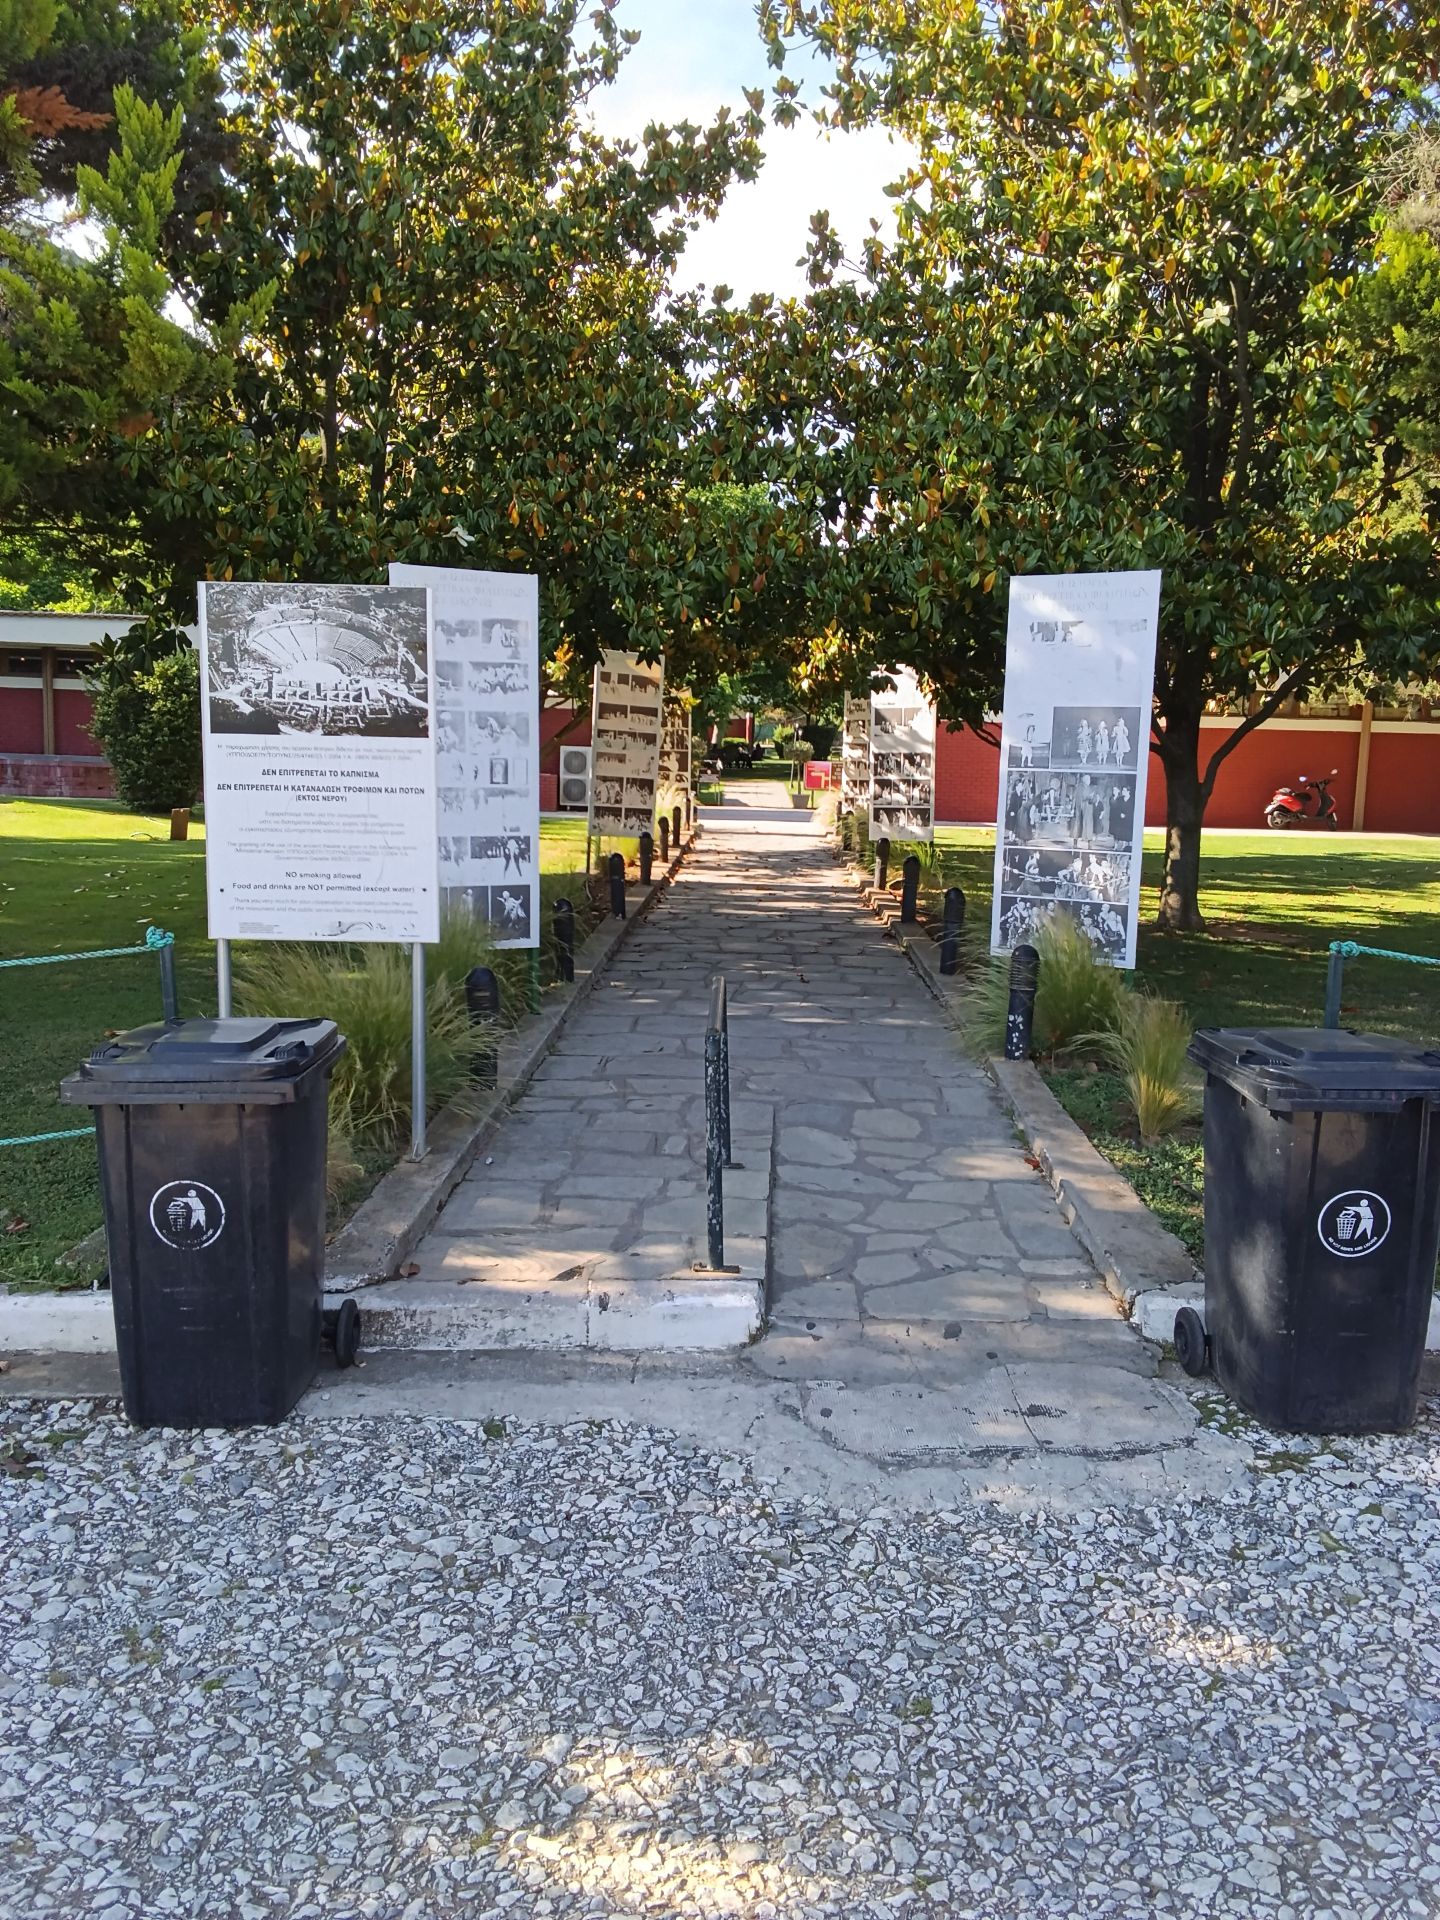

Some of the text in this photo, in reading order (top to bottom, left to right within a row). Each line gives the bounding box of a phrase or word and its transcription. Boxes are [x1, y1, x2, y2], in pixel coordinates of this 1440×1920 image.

[278, 769, 327, 777] ΕΠΙΤΡΕΠΕΤΑΙ
[340, 770, 380, 778] ΚΑΠΝΙΣΜΑ
[233, 784, 282, 792] ΕΠΙΤΡΕΠΕΤΑΙ
[291, 785, 341, 793] ΚΑΤΑΝΑΛΩΣΗ
[299, 872, 331, 880] smoking
